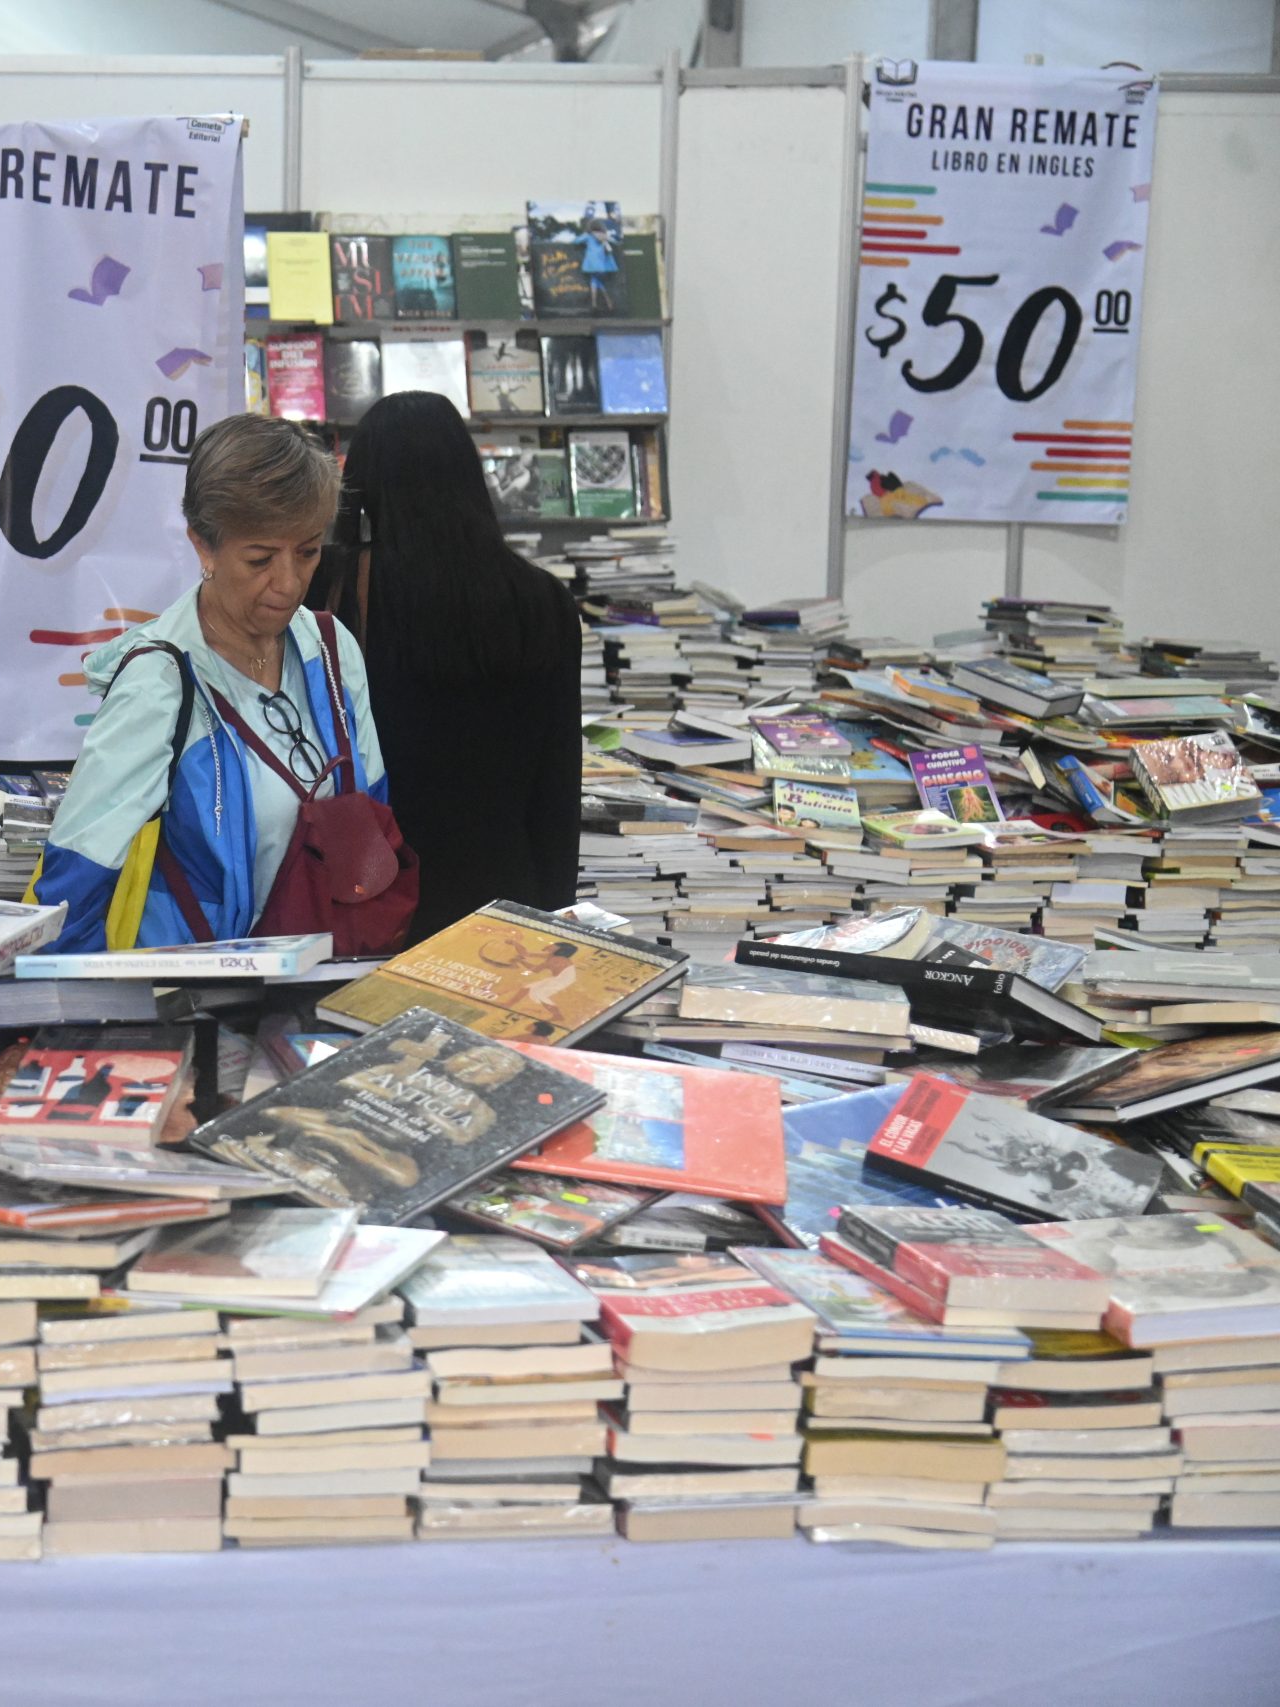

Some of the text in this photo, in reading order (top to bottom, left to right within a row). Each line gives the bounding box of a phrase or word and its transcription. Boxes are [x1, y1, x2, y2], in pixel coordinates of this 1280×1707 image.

[188, 131, 221, 143] Editorial
[190, 119, 223, 132] Cometa
[906, 103, 1140, 149] GRAN REMATE
[931, 149, 1096, 178] LIBRO EN INGLES
[0, 147, 200, 219] REMATE
[925, 758, 967, 770] CURATIVO
[931, 750, 960, 761] PODER
[921, 769, 985, 787] GINSENG
[778, 780, 855, 804] Anorexia
[787, 793, 853, 814] Bulimia
[219, 956, 258, 971] Yoga
[924, 969, 1006, 994] ANGKOR folio
[406, 1066, 478, 1106] INDIA
[367, 1073, 475, 1129] ANTIGUA
[901, 1209, 1005, 1232] KERR
